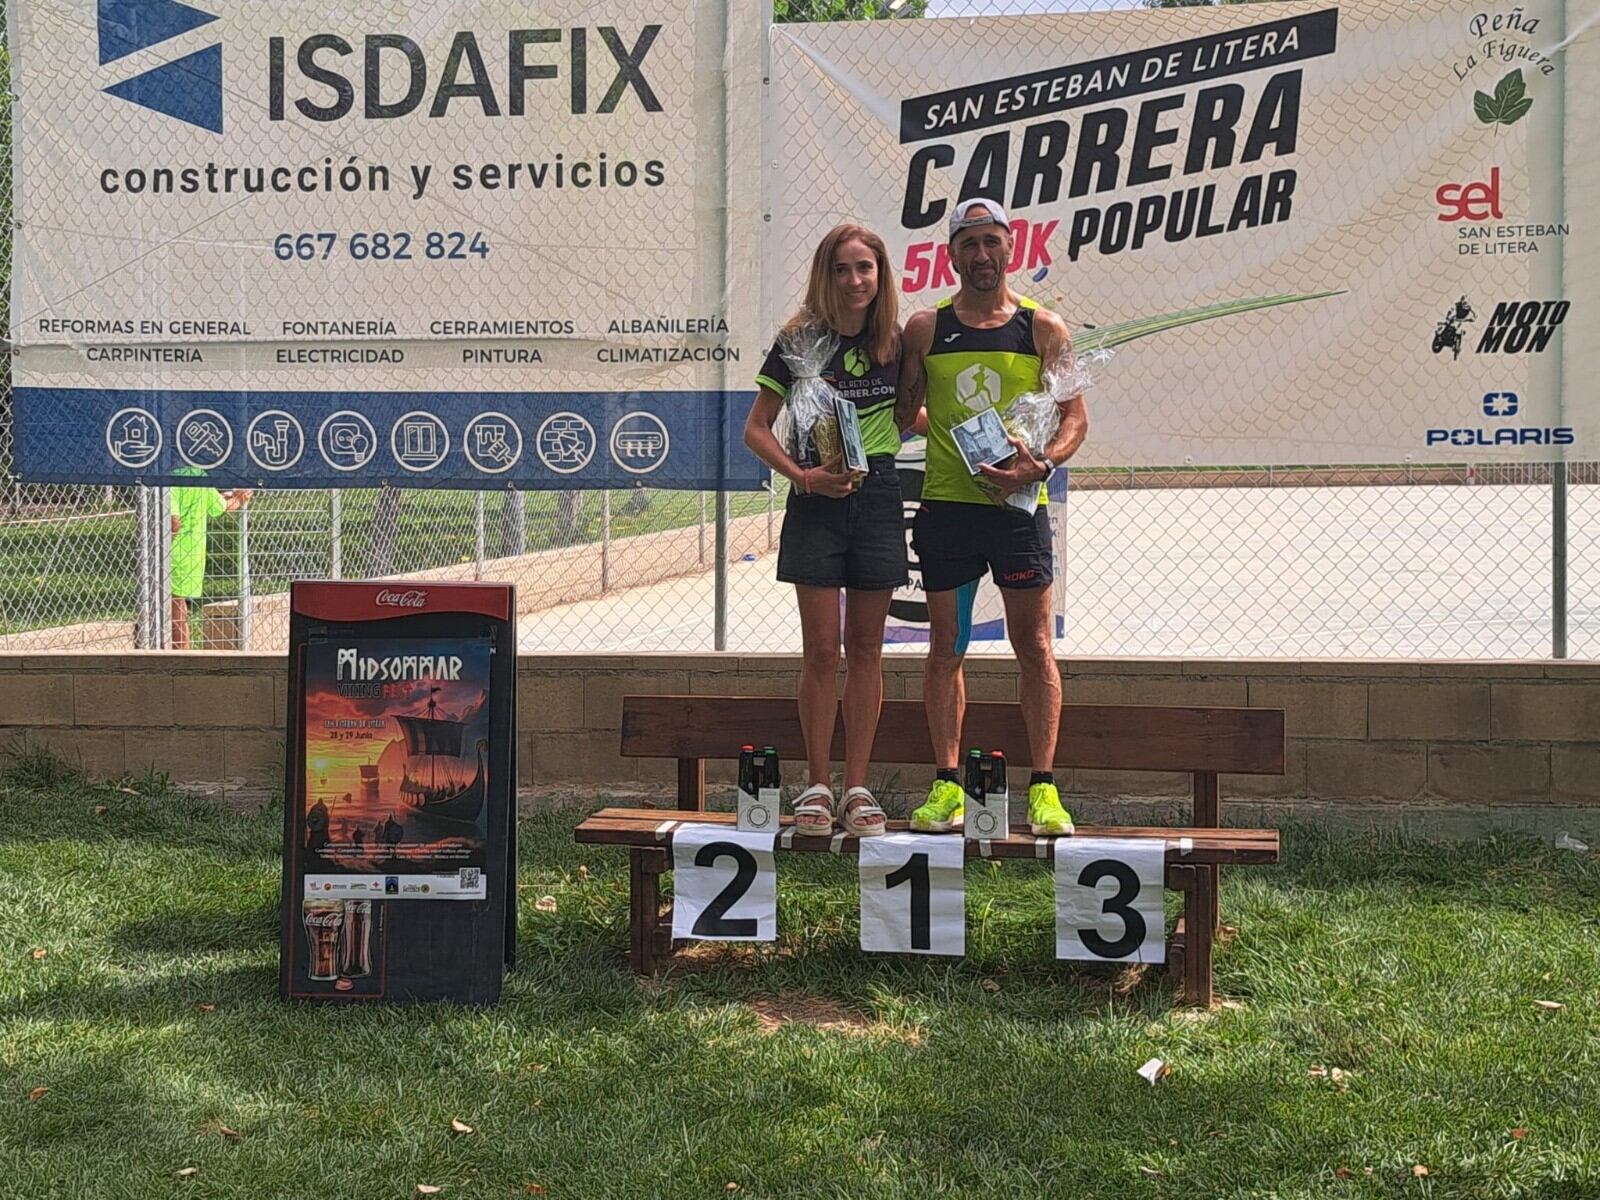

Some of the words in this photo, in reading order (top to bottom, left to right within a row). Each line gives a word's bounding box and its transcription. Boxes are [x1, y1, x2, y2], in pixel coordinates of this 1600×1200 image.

[1469, 7, 1541, 39] Peña
[269, 24, 664, 121] ISDAFIX
[1453, 55, 1478, 82] La
[1483, 38, 1555, 76] Figuera
[924, 95, 984, 131] SAN
[994, 63, 1131, 115] ESTEBAN
[1140, 52, 1183, 83] DE
[1192, 26, 1299, 72] LITERA
[901, 69, 1303, 230] CARRERA
[100, 156, 389, 193] construcción
[411, 164, 432, 199] y
[452, 153, 665, 190] servicios
[1436, 167, 1503, 221] sel
[1068, 169, 1297, 261] POPULAR
[1458, 226, 1491, 239] SAN
[1497, 224, 1569, 238] ESTEBAN
[274, 233, 337, 260] 667
[349, 233, 412, 260] 682
[425, 232, 490, 259] 824
[1458, 243, 1480, 255] DE
[1485, 241, 1539, 254] LITERA
[39, 319, 134, 334] REFORMAS
[140, 321, 163, 334] EN
[169, 321, 251, 335] GENERAL
[282, 317, 397, 335] FONTANERÍA
[430, 320, 574, 335] CERRAMIENTOS
[608, 315, 729, 334] ALBAÑILERÍA
[1489, 301, 1571, 327] MOTO
[597, 344, 740, 362] CLIMATIZACIÓN
[1475, 326, 1556, 354] MON
[86, 348, 203, 362] CARPINTERÍA
[276, 349, 404, 363] ELECTRICIDAD
[463, 349, 543, 363] PINTURA
[1426, 428, 1575, 446] POLARIS
[692, 842, 758, 937] 2
[885, 853, 930, 950] 1
[1077, 860, 1146, 959] 3
